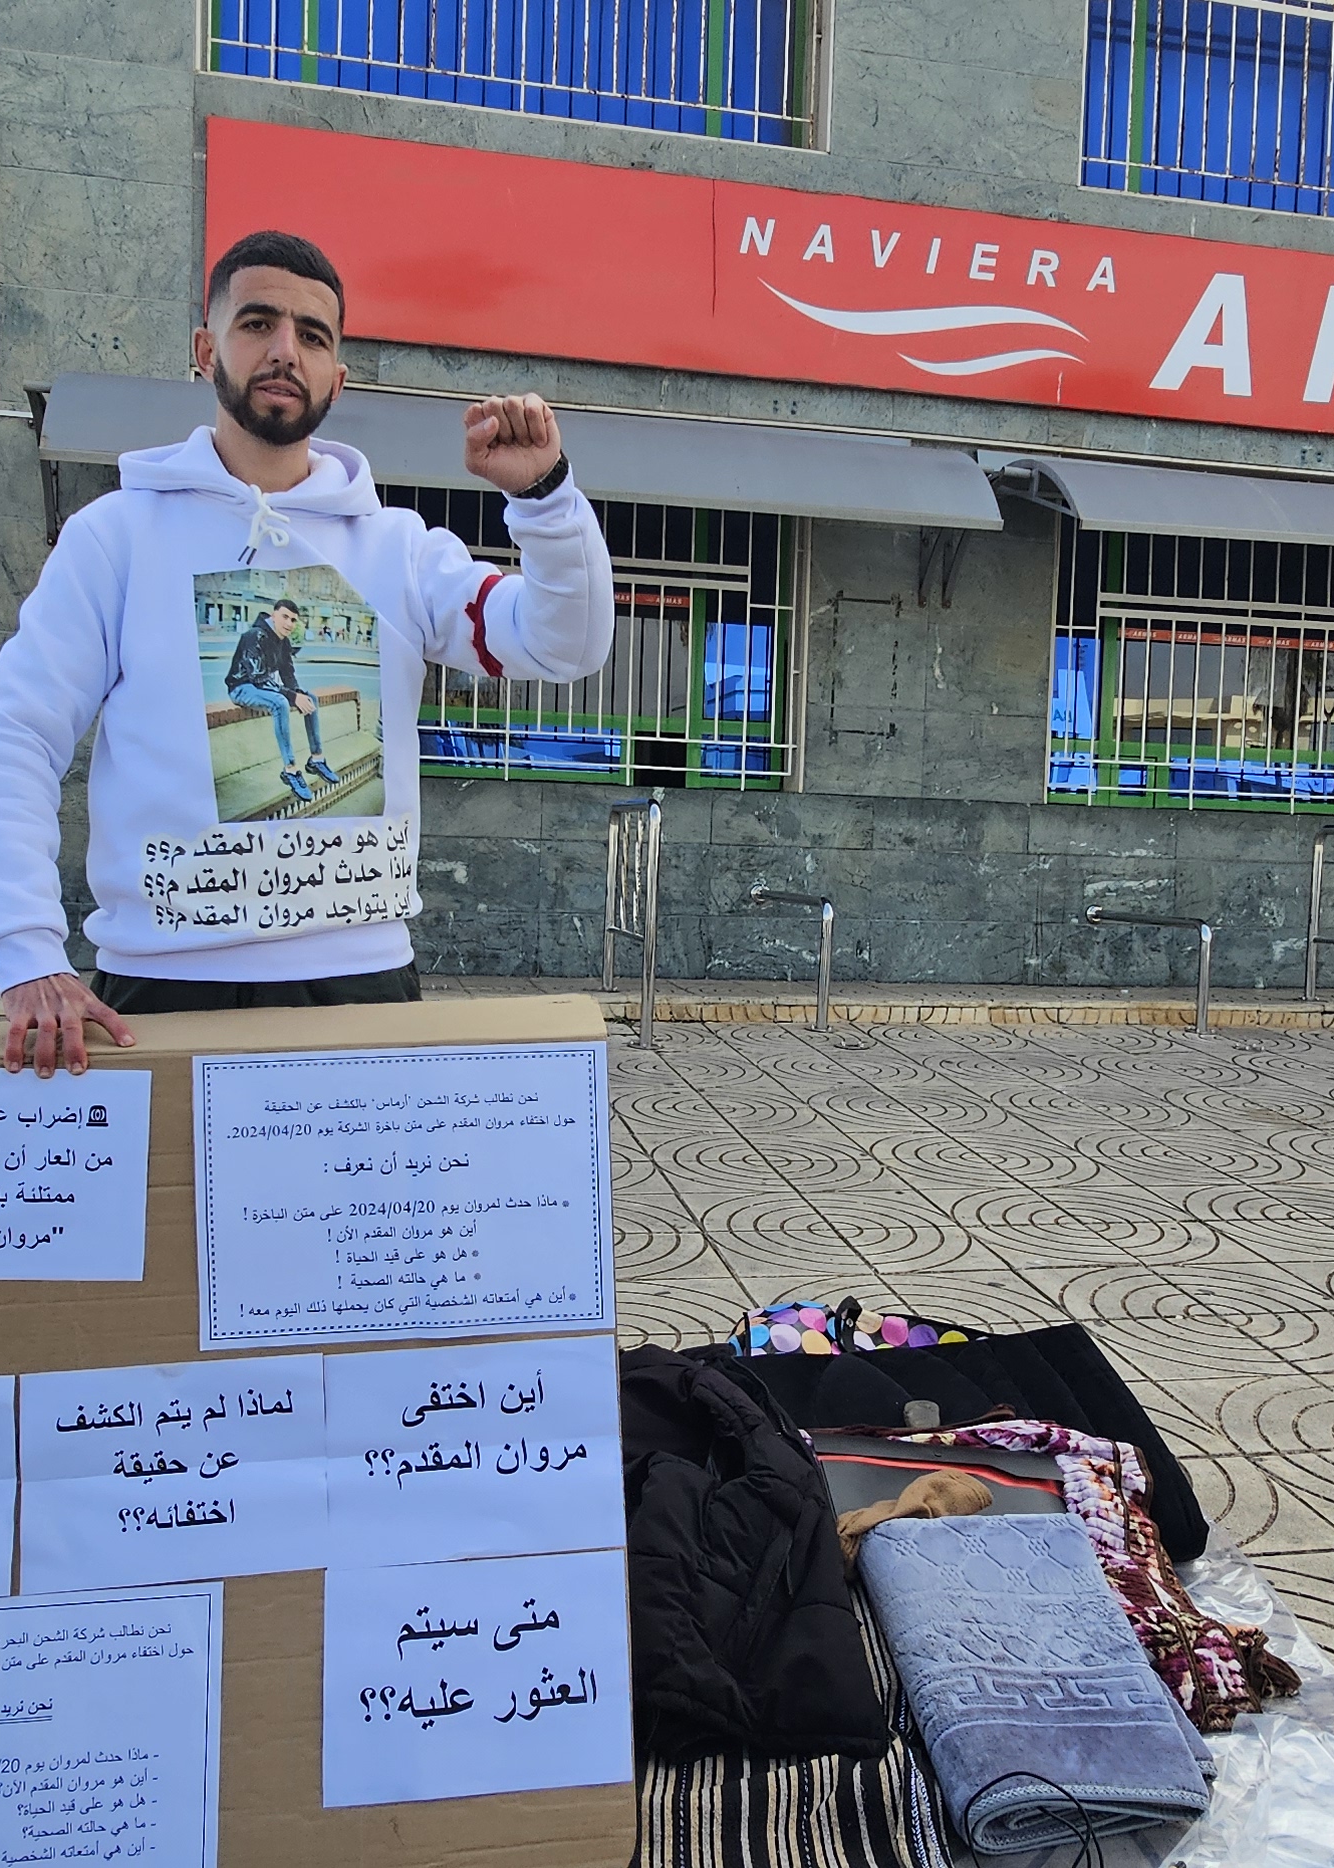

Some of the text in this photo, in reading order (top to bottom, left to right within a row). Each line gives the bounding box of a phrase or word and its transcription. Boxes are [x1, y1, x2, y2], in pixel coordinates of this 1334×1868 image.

[739, 216, 1117, 294] NAVIERA
[276, 830, 343, 860] مروان
[350, 829, 379, 854] هو
[386, 820, 408, 852] أين
[257, 861, 326, 897] لمروان
[334, 858, 383, 885] حدث
[389, 856, 412, 880] ماذا
[258, 902, 315, 930] مروان
[326, 892, 388, 923] يتواجد
[394, 885, 412, 917] أين
[17, 1106, 83, 1130] إضراب
[4, 1143, 26, 1171] أن
[33, 1147, 76, 1172] العار
[84, 1152, 113, 1172] من
[55, 1388, 294, 1437] لماذا لم يتم الكشف
[401, 1368, 544, 1428] أين اختفى
[112, 1449, 240, 1485] عن حقيقة
[364, 1436, 588, 1491] مروان المقدم؟؟
[118, 1498, 235, 1533] اختفائه؟؟
[396, 1597, 560, 1662] متى سيتم
[359, 1666, 597, 1731] العثور عليه؟؟
